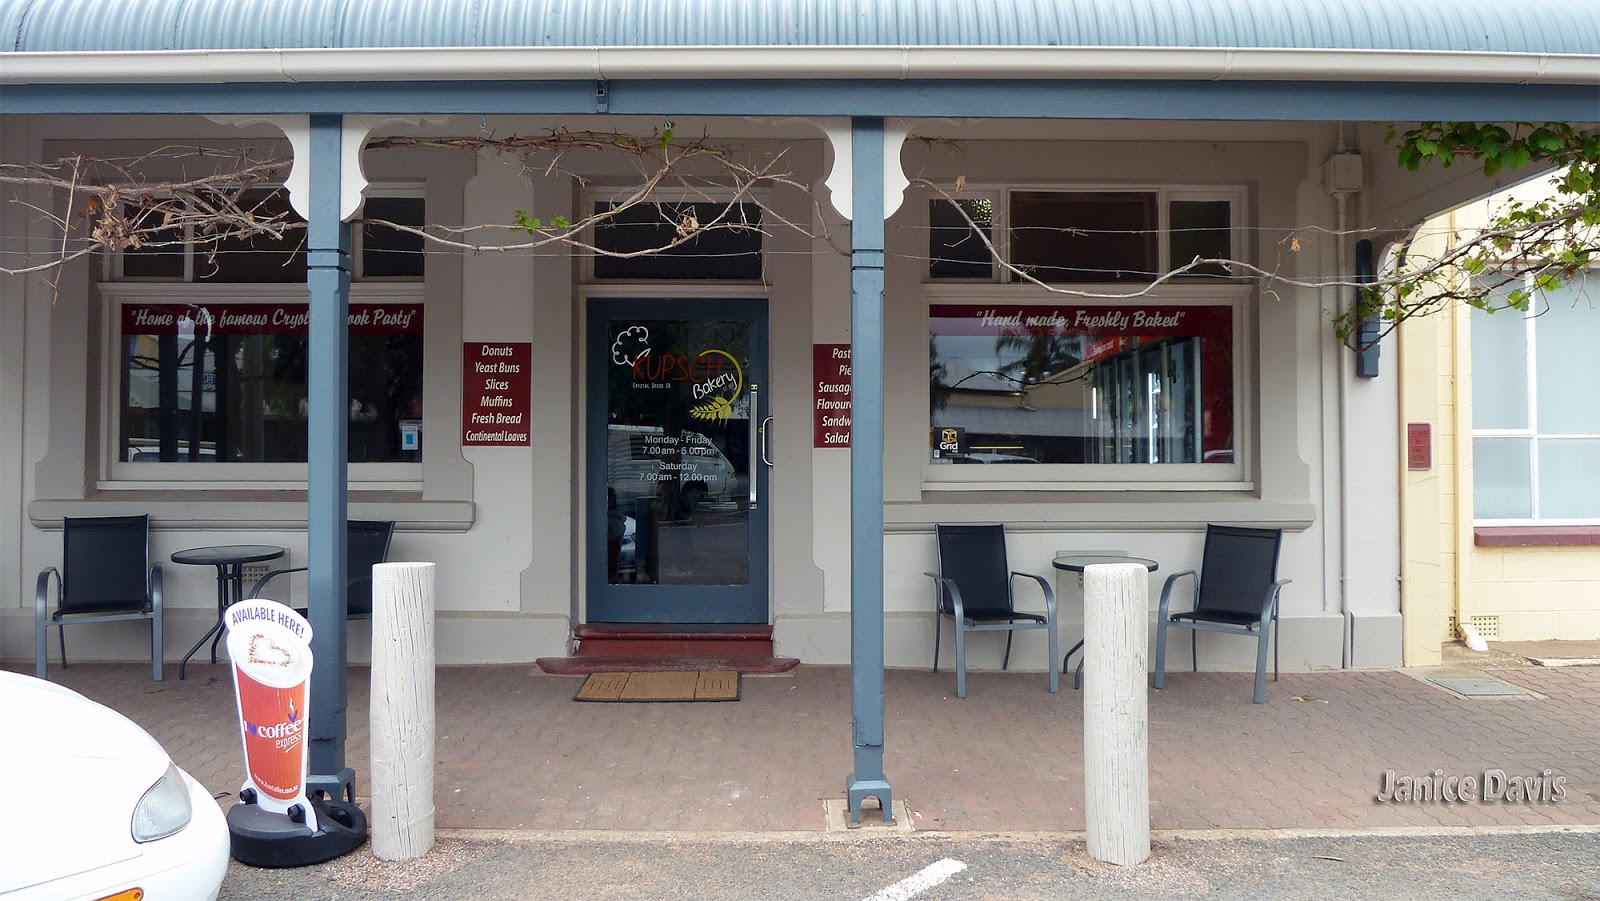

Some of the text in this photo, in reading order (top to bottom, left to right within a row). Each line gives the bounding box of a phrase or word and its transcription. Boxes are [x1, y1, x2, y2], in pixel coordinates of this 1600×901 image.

[131, 308, 416, 329] "Home of the famous Cryst ook Pasty"
[976, 309, 1185, 331] "Hand made, Freshly Baked"
[481, 345, 513, 356] Donuts
[832, 347, 851, 359] Past
[475, 361, 520, 373] Yeast Buns
[632, 354, 723, 382] KUPSCH
[839, 364, 852, 376] Pie
[484, 378, 509, 390] Slices
[692, 372, 738, 399] Bakery
[818, 381, 851, 396] Sausag
[480, 395, 513, 407] Muffins
[816, 398, 851, 410] Flavour
[471, 412, 522, 424] Fresh Bread
[821, 415, 852, 427] Sandw
[466, 430, 527, 442] Continental Loaves
[644, 435, 680, 446] Monday
[685, 436, 713, 446] Friday
[824, 432, 850, 444] Salad
[940, 441, 958, 450] Grid
[659, 461, 698, 473] Saturday
[232, 607, 305, 639] AVAILABLE HERE!
[257, 719, 302, 739] coffee
[275, 731, 302, 750] express
